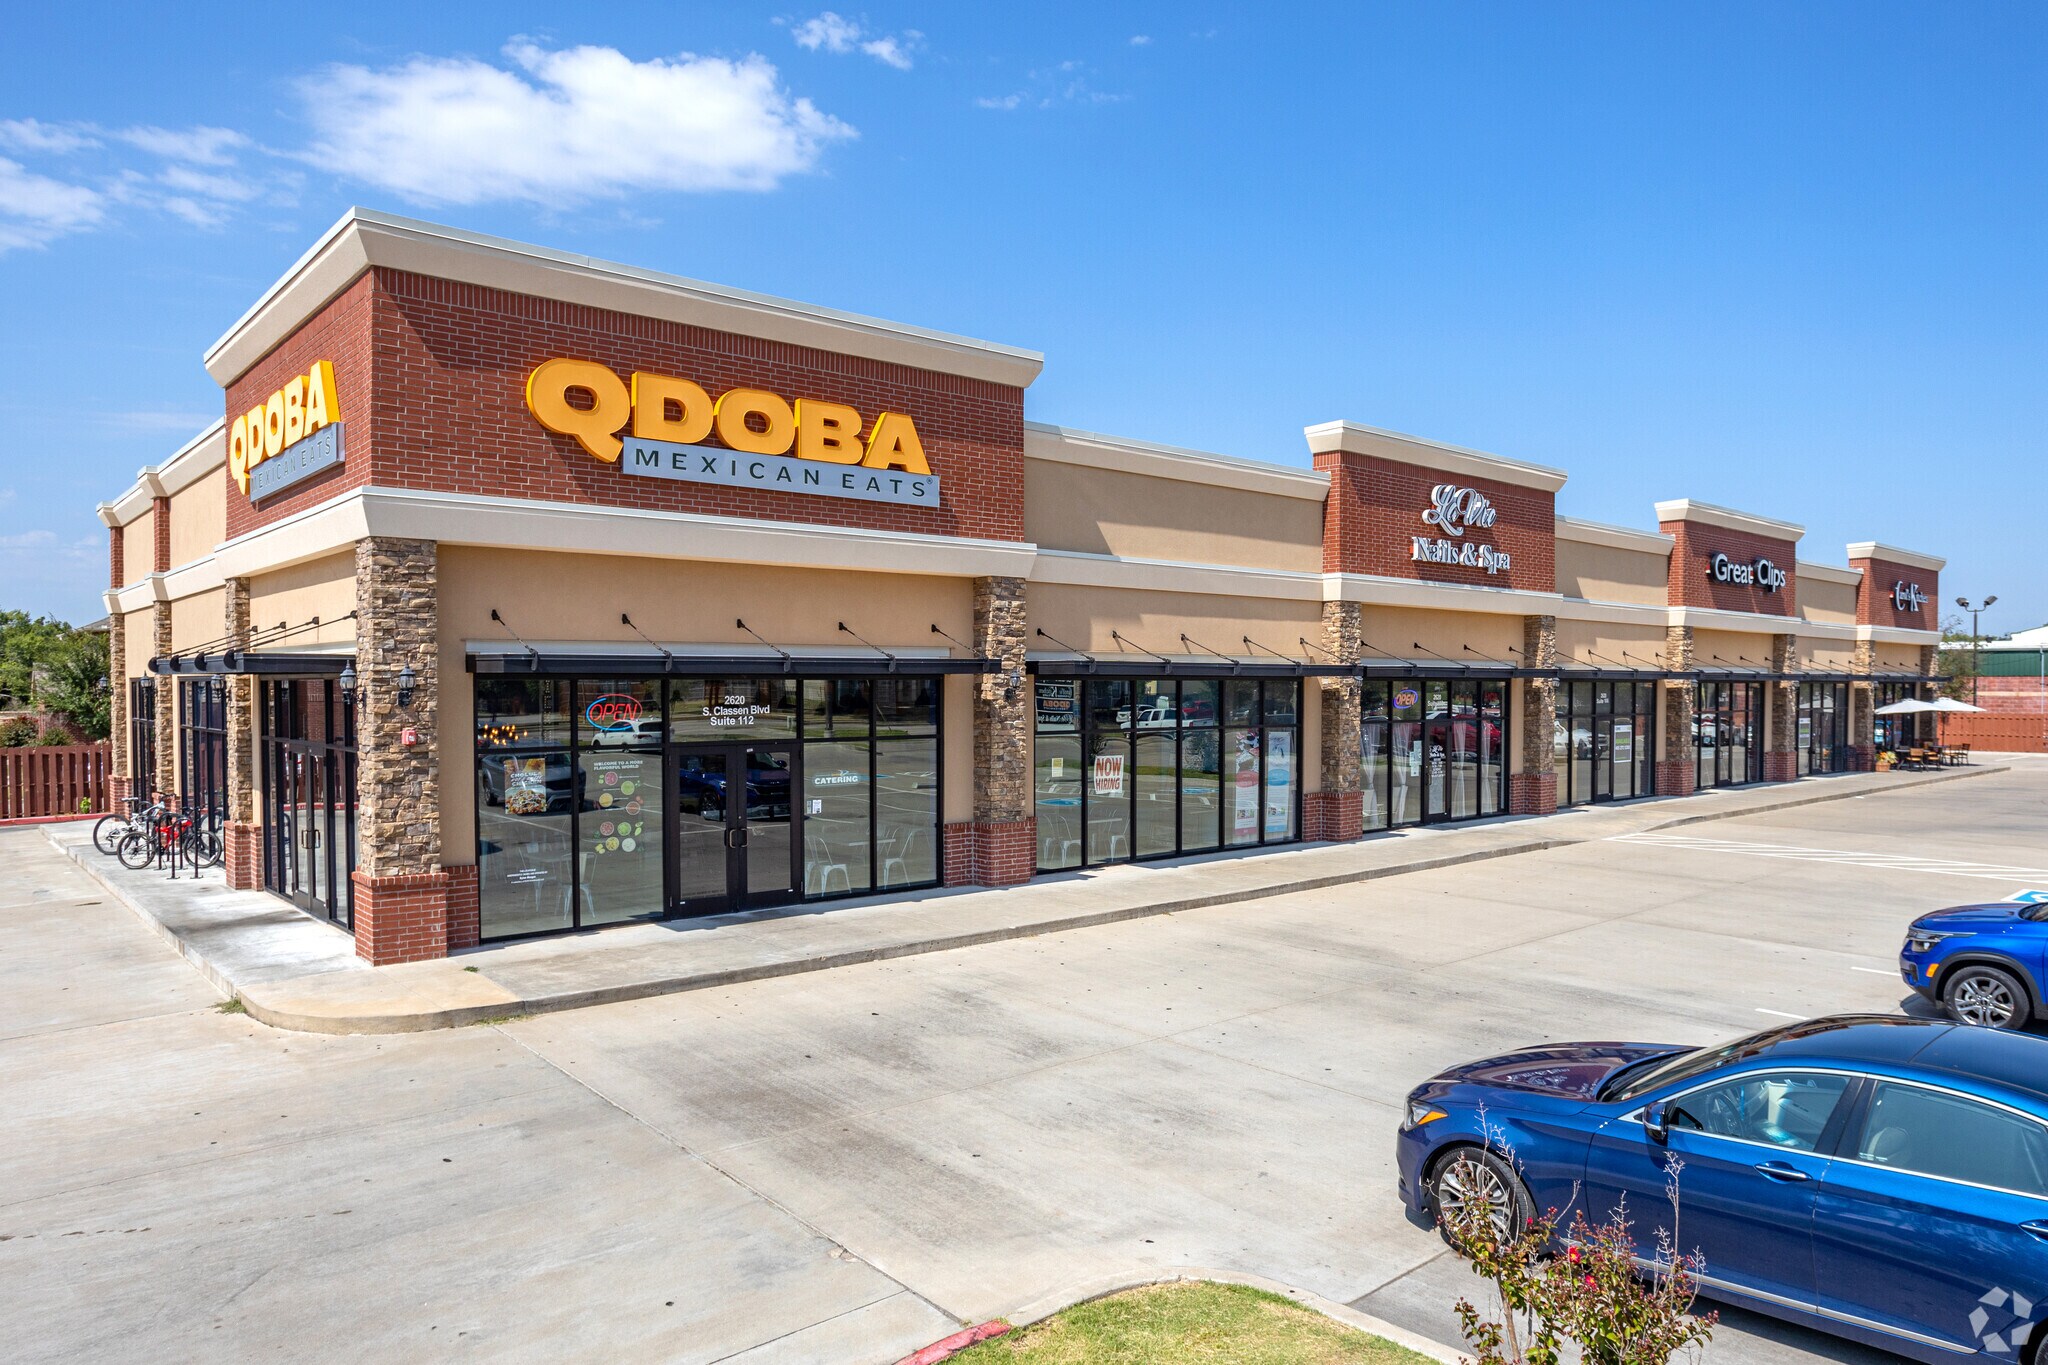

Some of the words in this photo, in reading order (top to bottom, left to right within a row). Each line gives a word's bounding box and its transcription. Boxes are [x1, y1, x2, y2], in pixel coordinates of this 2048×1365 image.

[526, 358, 931, 474] QDOBA
[229, 359, 341, 496] QDOBA
[634, 447, 821, 486] MEXICAN
[1411, 537, 1459, 564] Nails
[1460, 543, 1478, 566] &
[1478, 545, 1511, 575] Spa
[1712, 551, 1754, 585] Great
[1756, 557, 1786, 593] Clips
[724, 695, 746, 705] 2620
[1395, 693, 1415, 705] OPEN
[589, 703, 638, 721] OPEN
[702, 706, 712, 716] S.
[713, 705, 749, 716] Classen
[750, 704, 770, 715] Blvd
[710, 716, 736, 726] Suite
[738, 715, 754, 725] 112
[1095, 757, 1122, 777] NOW
[814, 776, 858, 785] CATERING
[1095, 777, 1120, 791] HIRING
